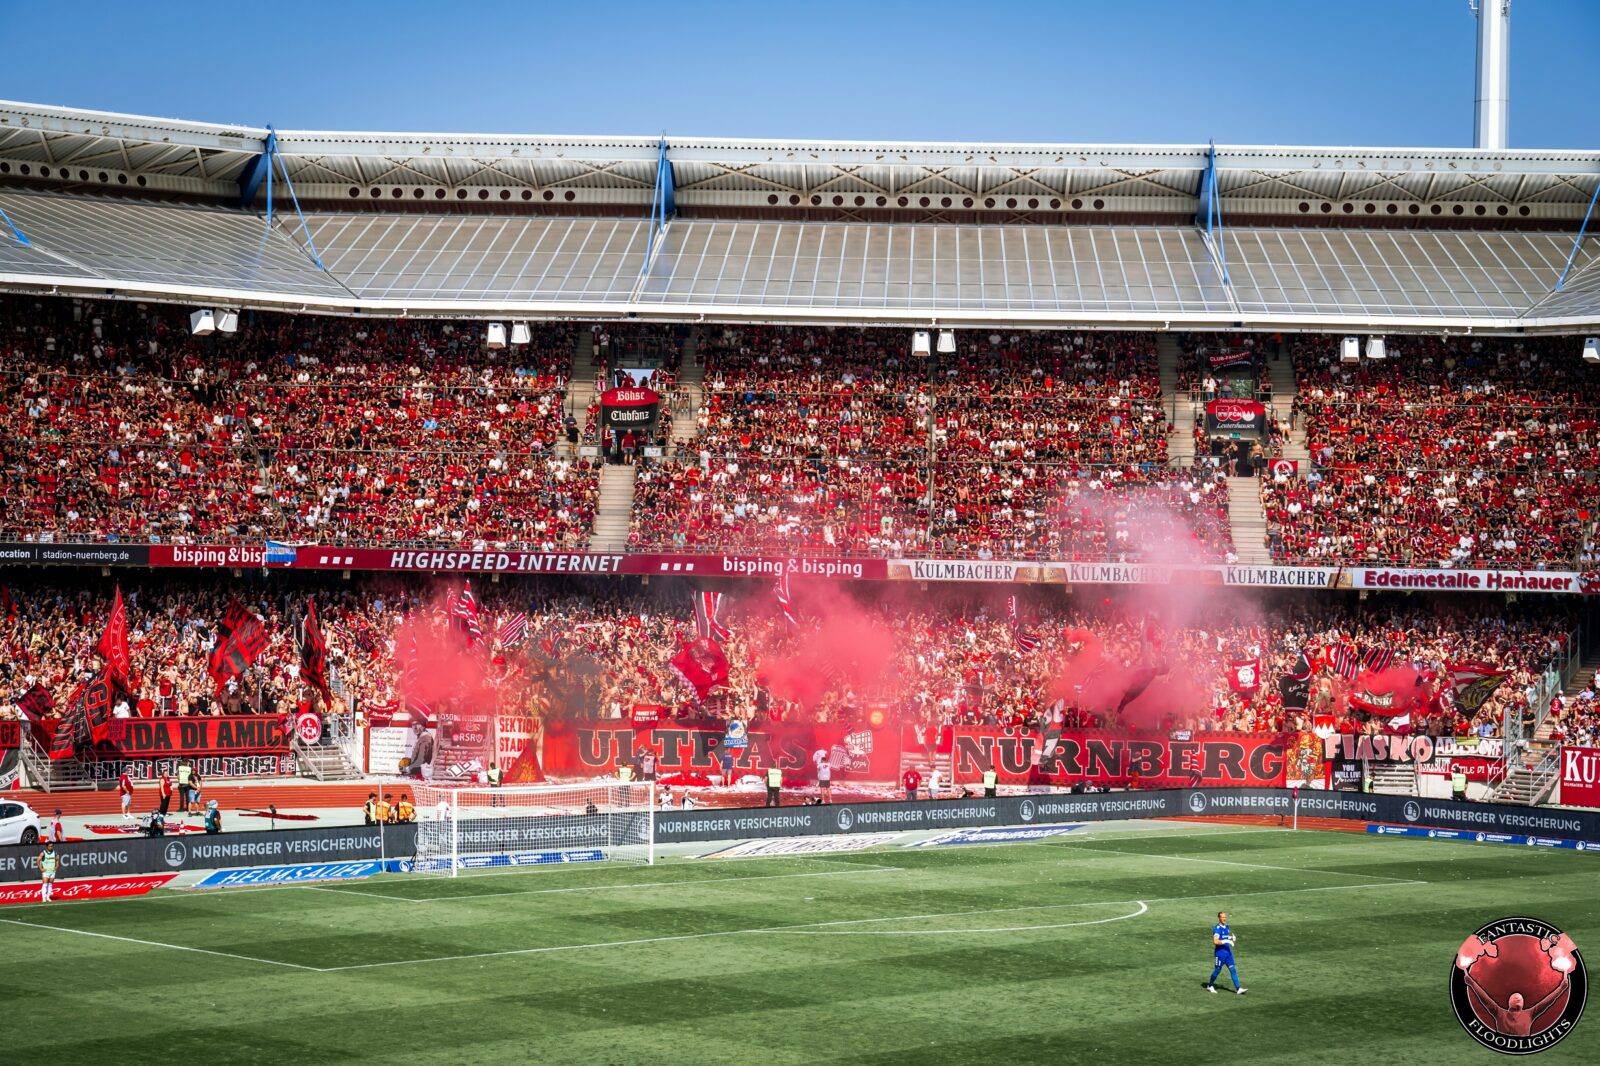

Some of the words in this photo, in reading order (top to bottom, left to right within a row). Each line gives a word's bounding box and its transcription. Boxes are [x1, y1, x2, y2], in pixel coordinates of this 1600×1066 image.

[616, 390, 646, 402] Böhse
[610, 410, 650, 421] Clubfanz
[42, 550, 130, 562] stadion-nuernberg.de
[173, 546, 226, 566] bisping
[228, 547, 240, 562] &
[390, 551, 624, 573] HIGHSPEED-INTERNET
[723, 556, 783, 575] bisping
[786, 558, 799, 573] &
[802, 559, 863, 578] bisping
[914, 561, 1013, 580] KULMBACHER
[1226, 566, 1327, 586] KULMBACHER
[1487, 573, 1573, 591] Hanauer
[302, 726, 317, 736] FCN
[499, 716, 539, 733] SEKTION
[179, 722, 208, 749] DI
[459, 733, 476, 742] RSR
[576, 728, 808, 770] ULTRAS
[956, 727, 1284, 780] NÜRNBERG
[1325, 734, 1434, 763] FIASKO
[1342, 764, 1355, 772] YOU
[1564, 750, 1600, 783] KU
[1038, 802, 1098, 815] NÜRNBERGER
[1100, 798, 1166, 812] VERSICHERUNG
[1210, 796, 1289, 808] NÜRNBERGER
[1294, 797, 1377, 813] VERSICHERUNG
[658, 819, 731, 834] NÜRNBERGER
[734, 815, 811, 831] VERSICHERUNG
[857, 810, 923, 824] NÜRNBERGER
[924, 806, 996, 821] VERSICHERUNG
[1424, 806, 1496, 825] NÜRNBERGER
[1498, 813, 1581, 832] VERSICHERUNG
[192, 841, 282, 859] NÜRNBERGER
[286, 836, 381, 853] VERSICHERUNG
